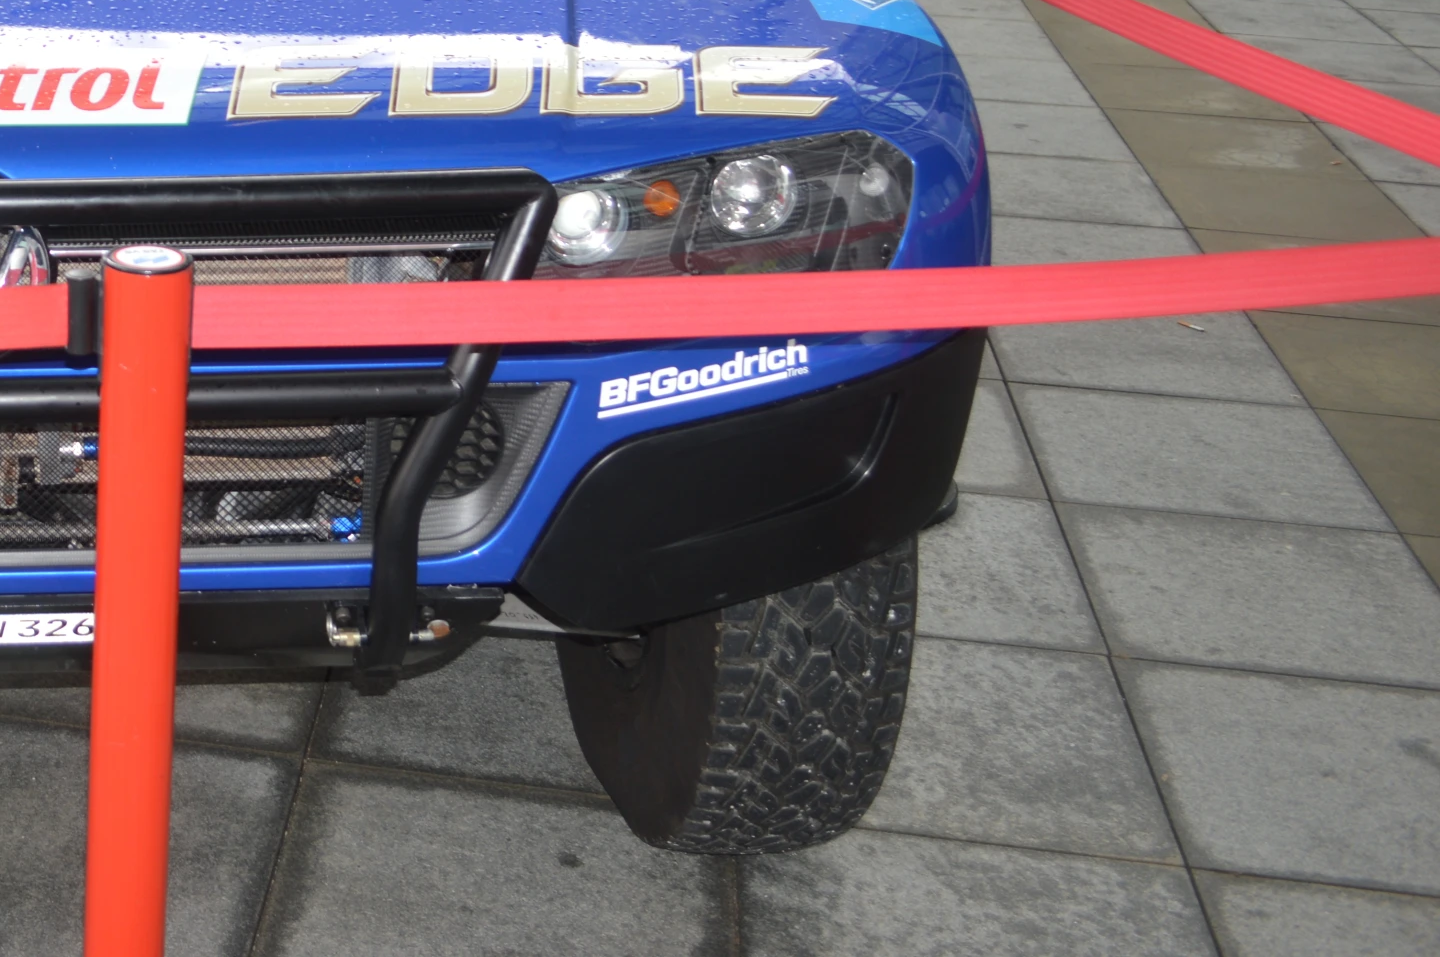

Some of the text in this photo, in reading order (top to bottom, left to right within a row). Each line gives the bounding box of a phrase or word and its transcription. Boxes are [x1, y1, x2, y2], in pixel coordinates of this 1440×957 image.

[226, 44, 839, 120] EDGE
[598, 338, 808, 409] BFGoodrich
[786, 365, 809, 378] Tires
